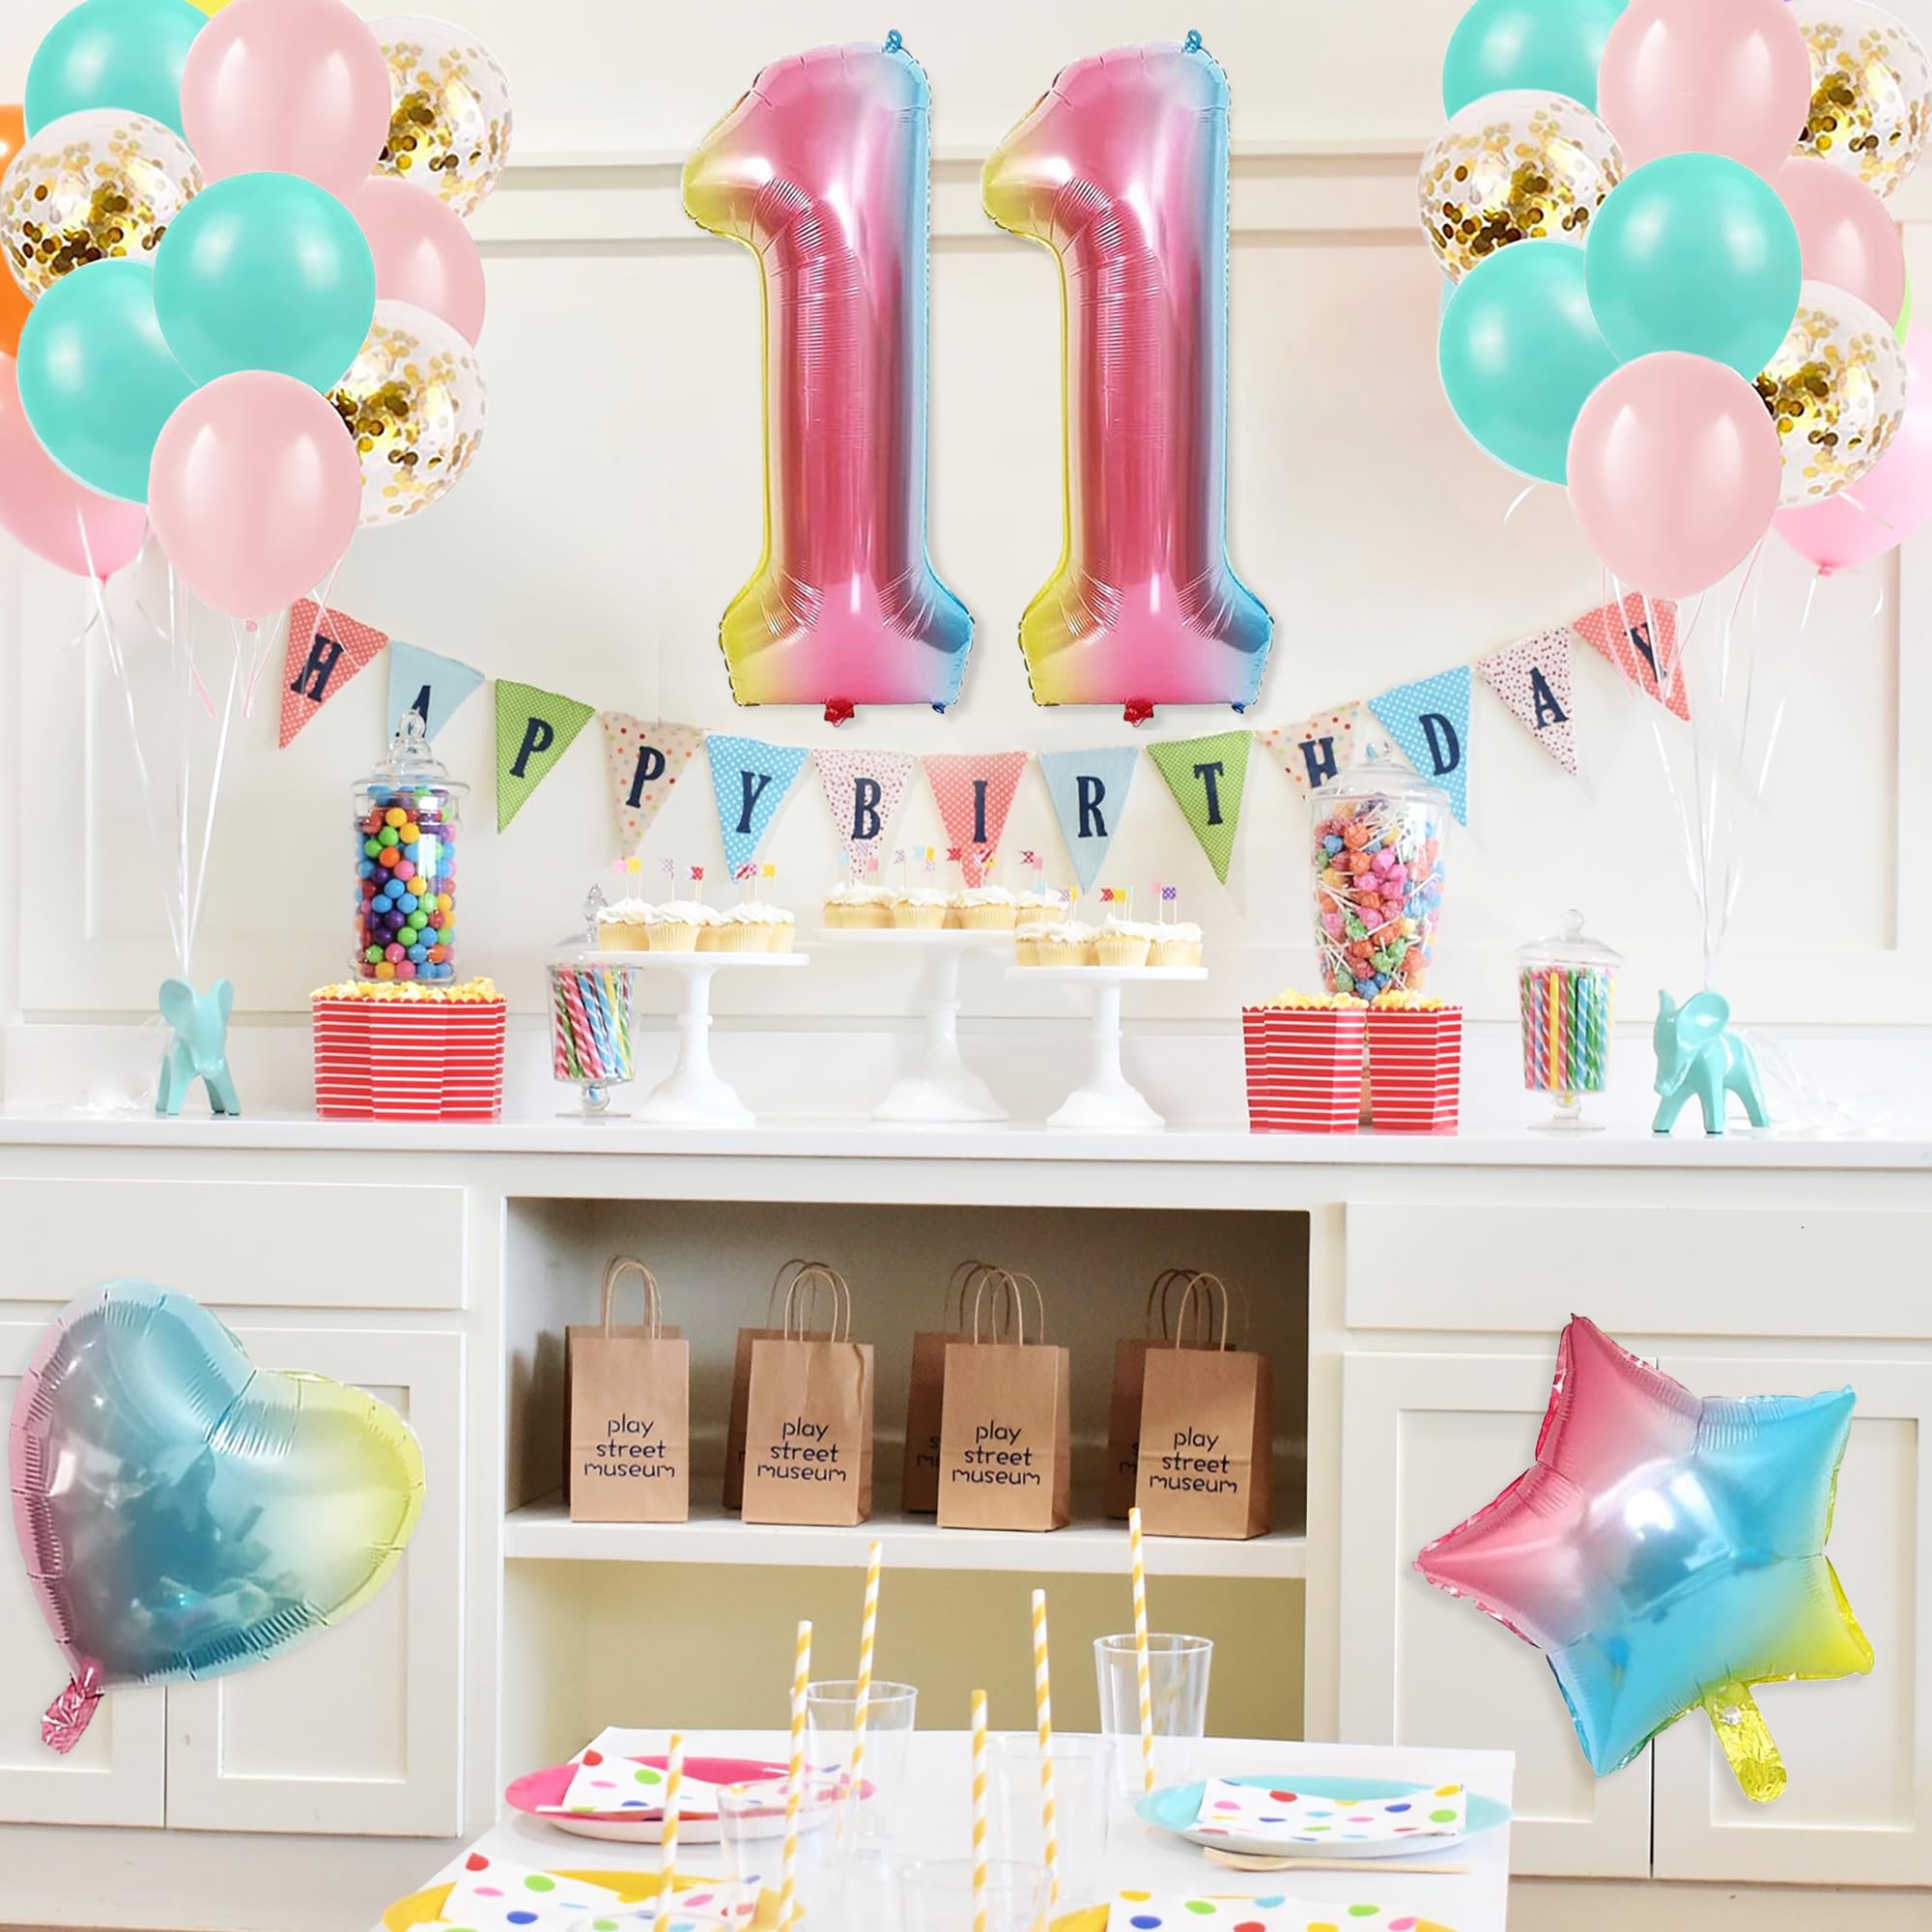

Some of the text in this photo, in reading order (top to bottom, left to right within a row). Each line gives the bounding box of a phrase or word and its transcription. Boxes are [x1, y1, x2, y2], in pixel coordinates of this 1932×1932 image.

[607, 1413, 654, 1439] play
[781, 1416, 830, 1442] play
[975, 1419, 1022, 1446] play
[595, 1439, 667, 1460] street
[1174, 1426, 1219, 1453] play
[770, 1441, 839, 1463] street
[964, 1445, 1033, 1466] street
[1161, 1451, 1230, 1474] street
[582, 1463, 675, 1479] museum
[756, 1463, 846, 1482] museum
[952, 1468, 1040, 1486] museum
[1149, 1473, 1237, 1493] museum
